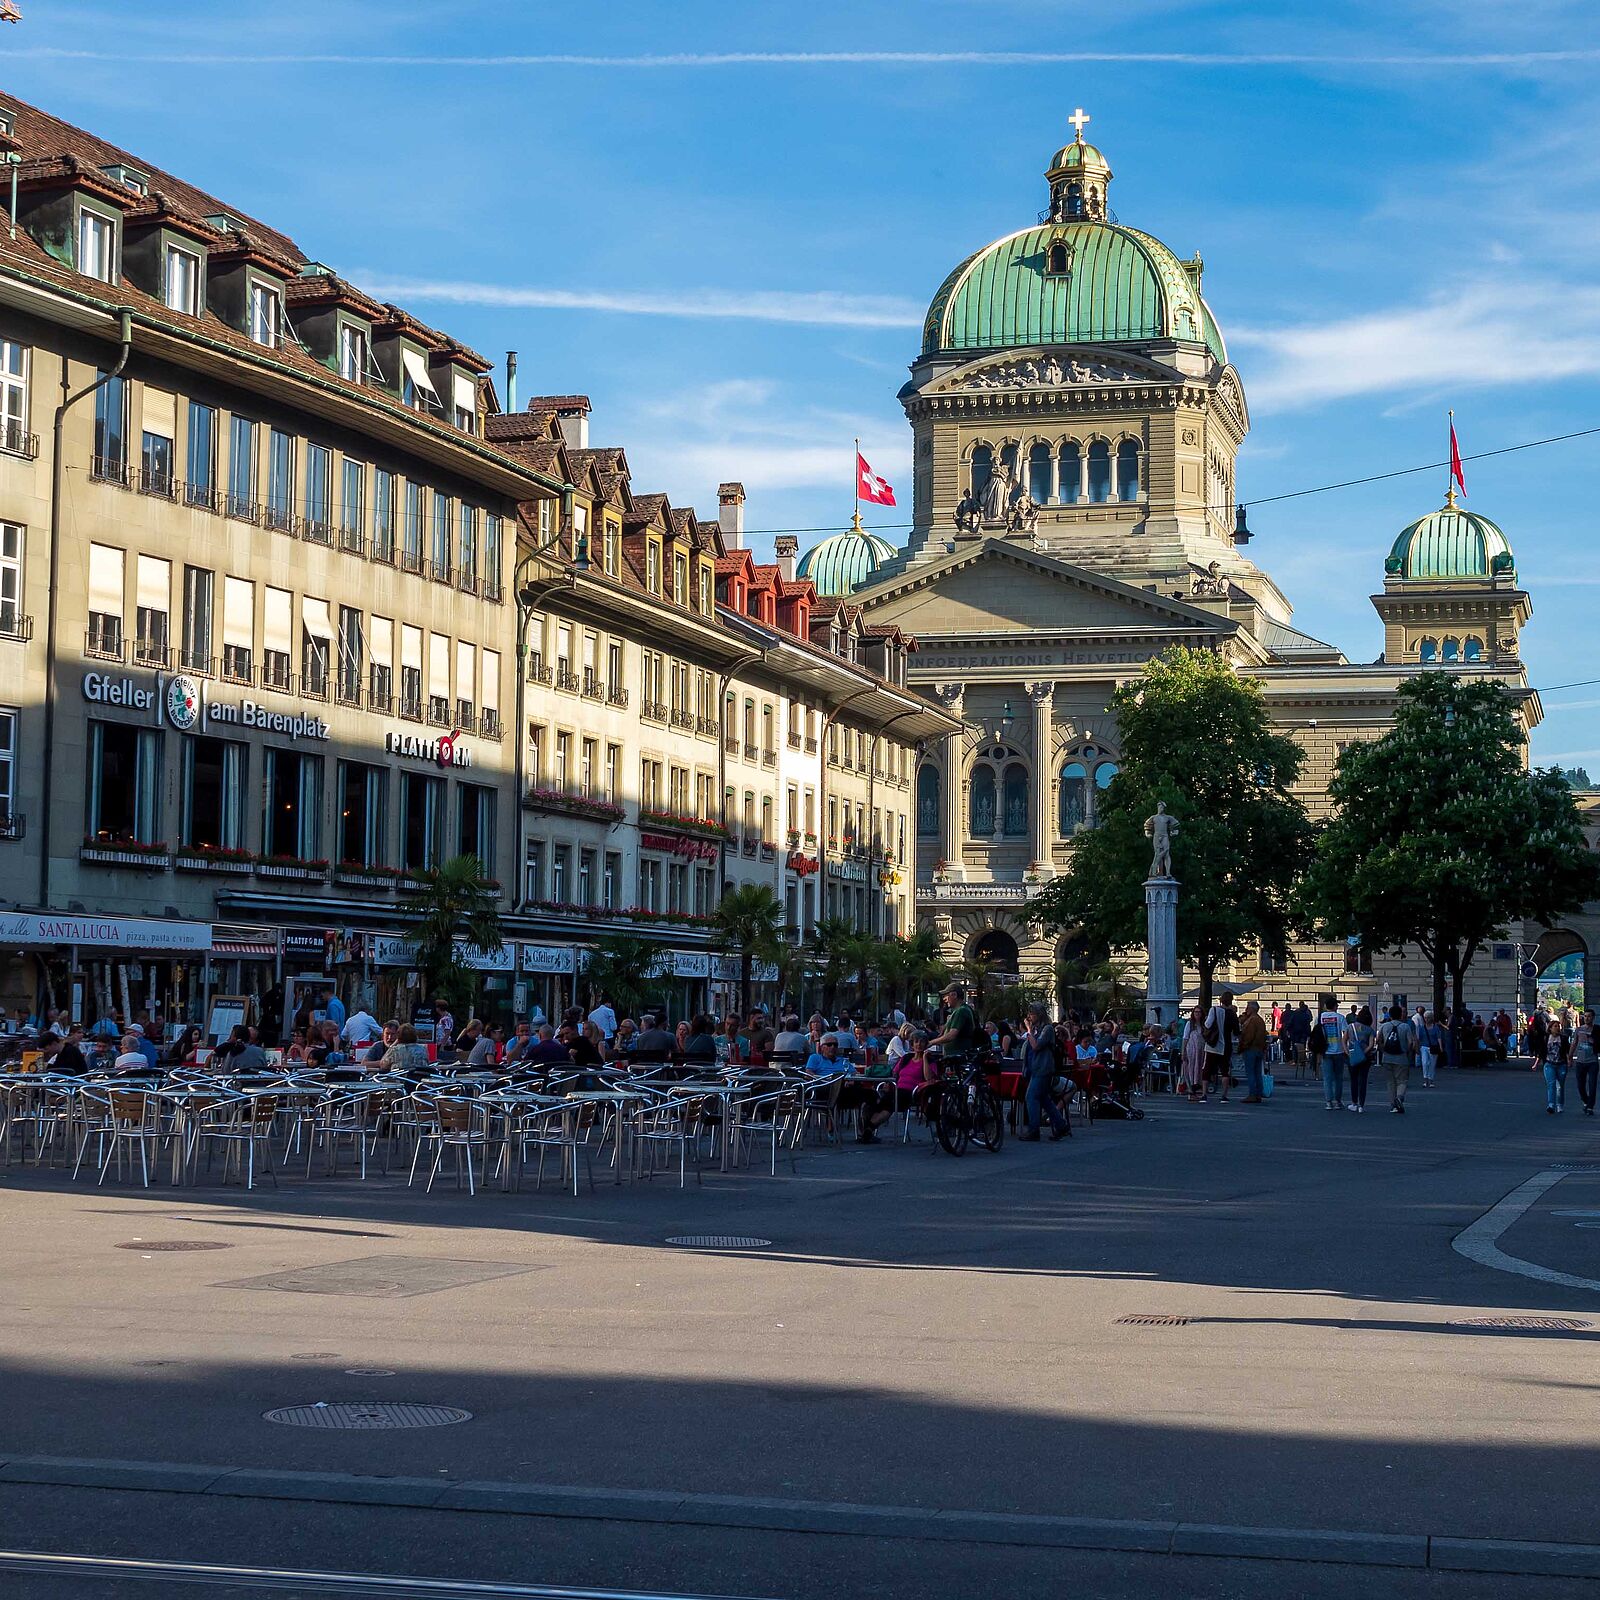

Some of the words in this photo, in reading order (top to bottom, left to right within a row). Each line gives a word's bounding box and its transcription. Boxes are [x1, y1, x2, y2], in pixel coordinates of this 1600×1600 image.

[907, 655, 1052, 668] ONFOEDERATIONIS
[84, 672, 154, 709] Gfeller
[210, 701, 237, 722] am
[243, 699, 331, 740] Bärenplatz
[8, 917, 30, 935] alla
[38, 921, 80, 938] SANTA
[82, 923, 119, 940] LUCIA
[151, 933, 170, 944] pasta
[177, 934, 195, 944] vino
[286, 936, 324, 946] PLATTFORM
[532, 950, 554, 963] Gfeller
